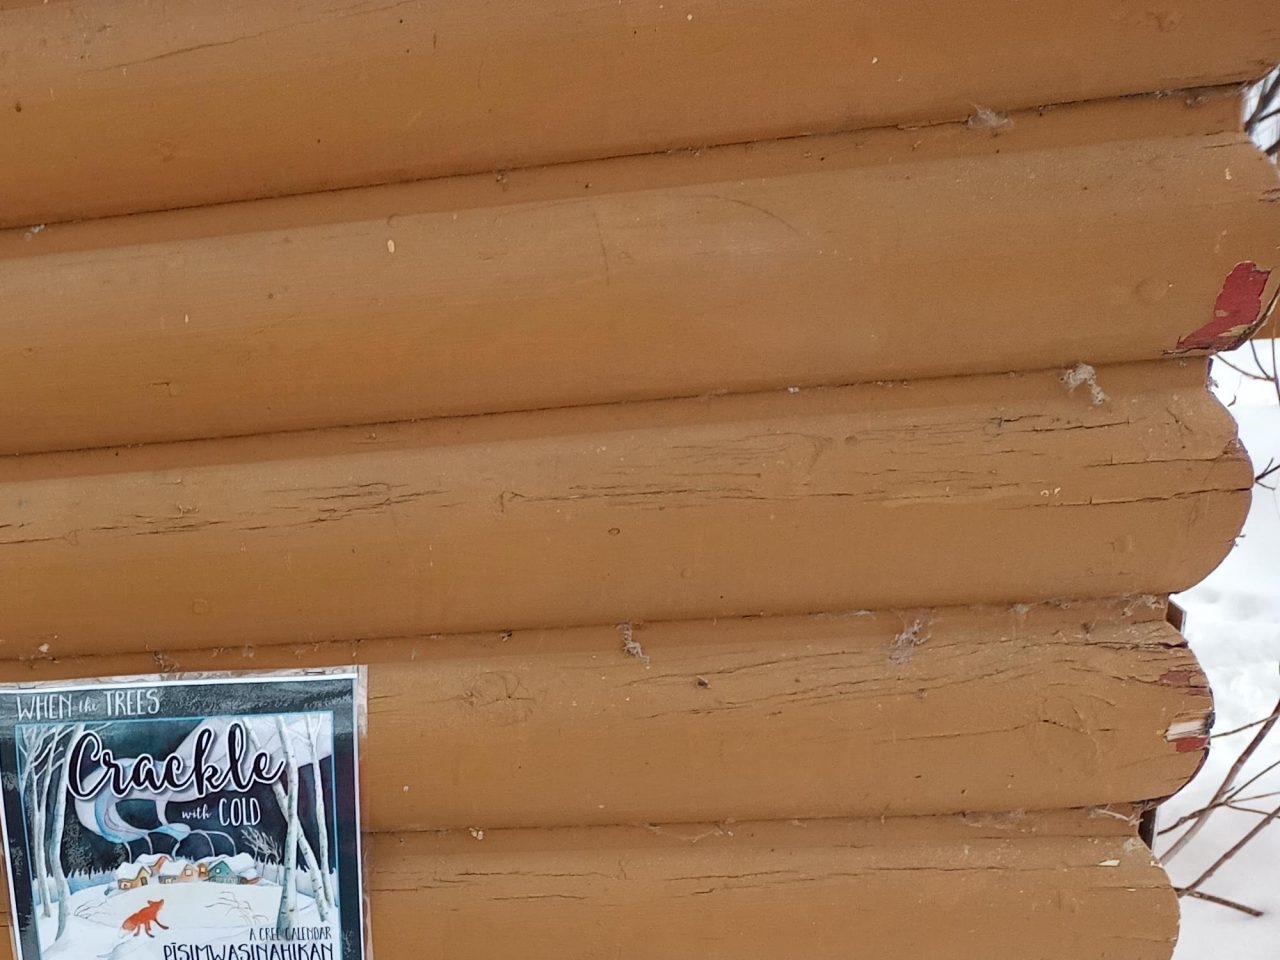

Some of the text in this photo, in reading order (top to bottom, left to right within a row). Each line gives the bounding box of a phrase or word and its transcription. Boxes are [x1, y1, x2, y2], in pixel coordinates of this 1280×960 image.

[17, 690, 160, 722] WHEN the TREES
[67, 722, 286, 800] Crackle
[182, 797, 260, 826] with COLD
[250, 926, 332, 941] A CREE CALENDAR
